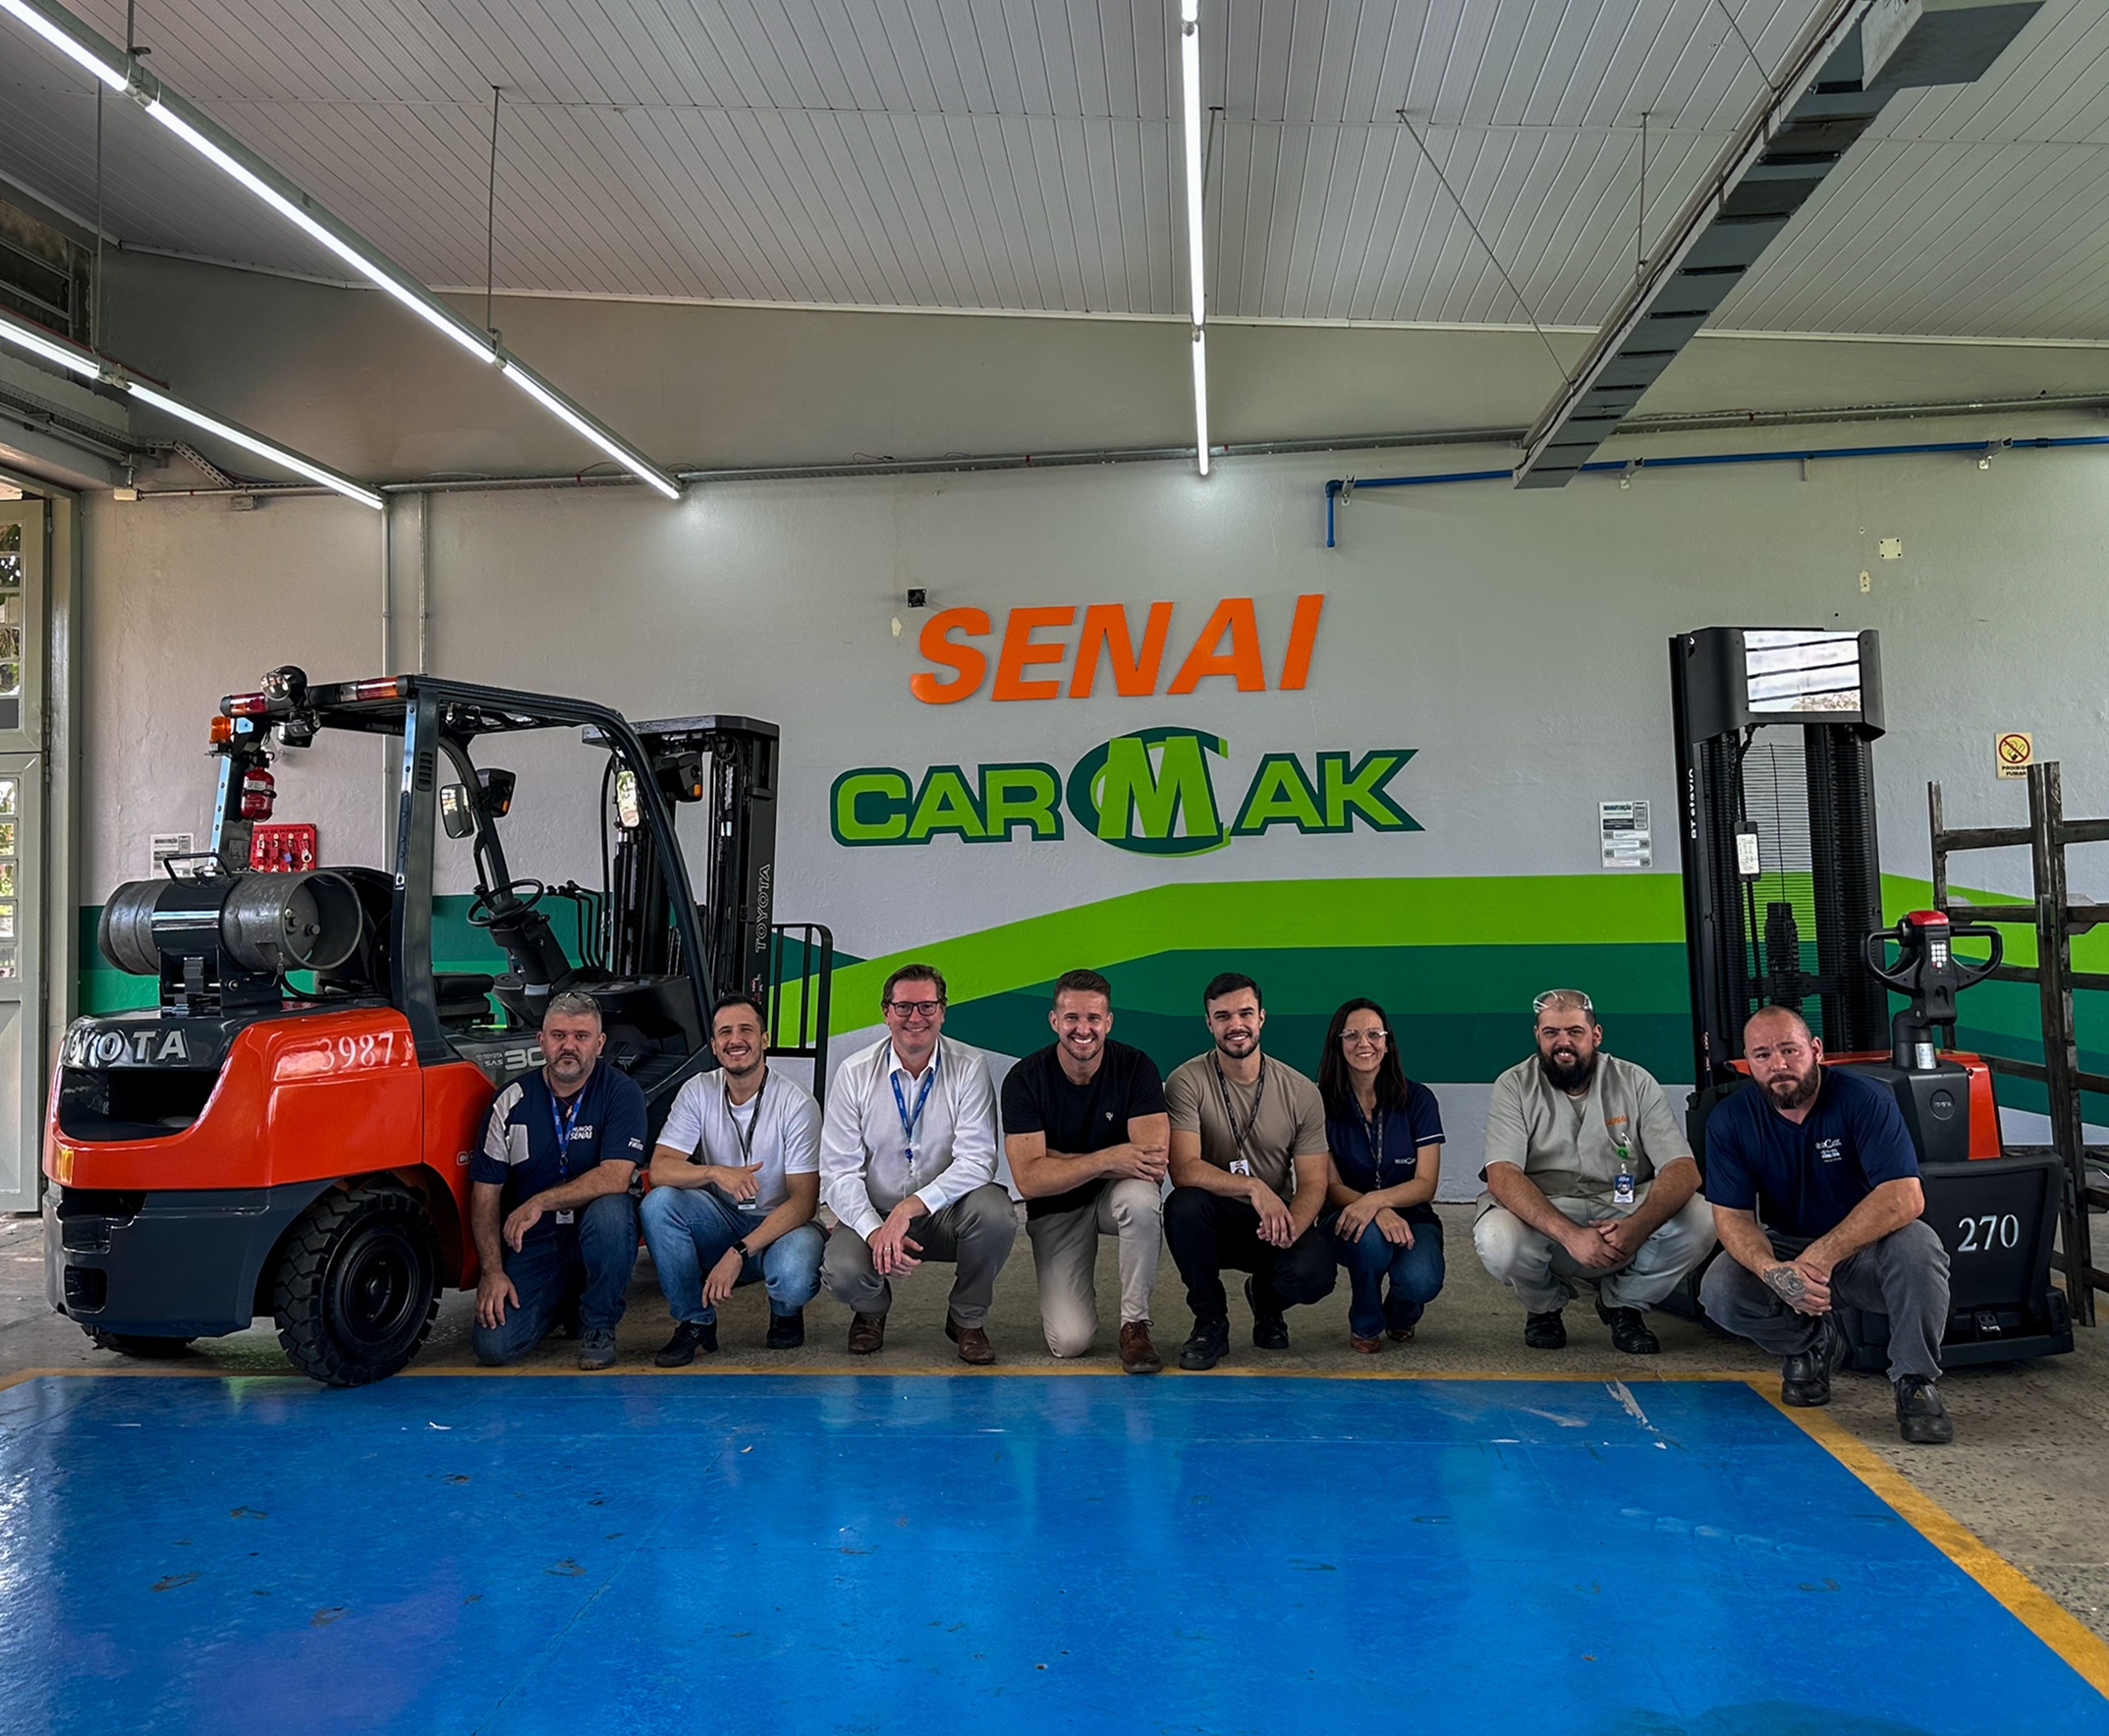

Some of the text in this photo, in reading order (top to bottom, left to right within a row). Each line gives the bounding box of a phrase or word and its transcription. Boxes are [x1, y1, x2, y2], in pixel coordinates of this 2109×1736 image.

[910, 593, 1324, 704] SENAI
[830, 726, 1427, 858] CARMAK
[754, 864, 771, 953] TOYOTA
[317, 1032, 394, 1070] 3987
[1958, 1213, 2020, 1252] 270
